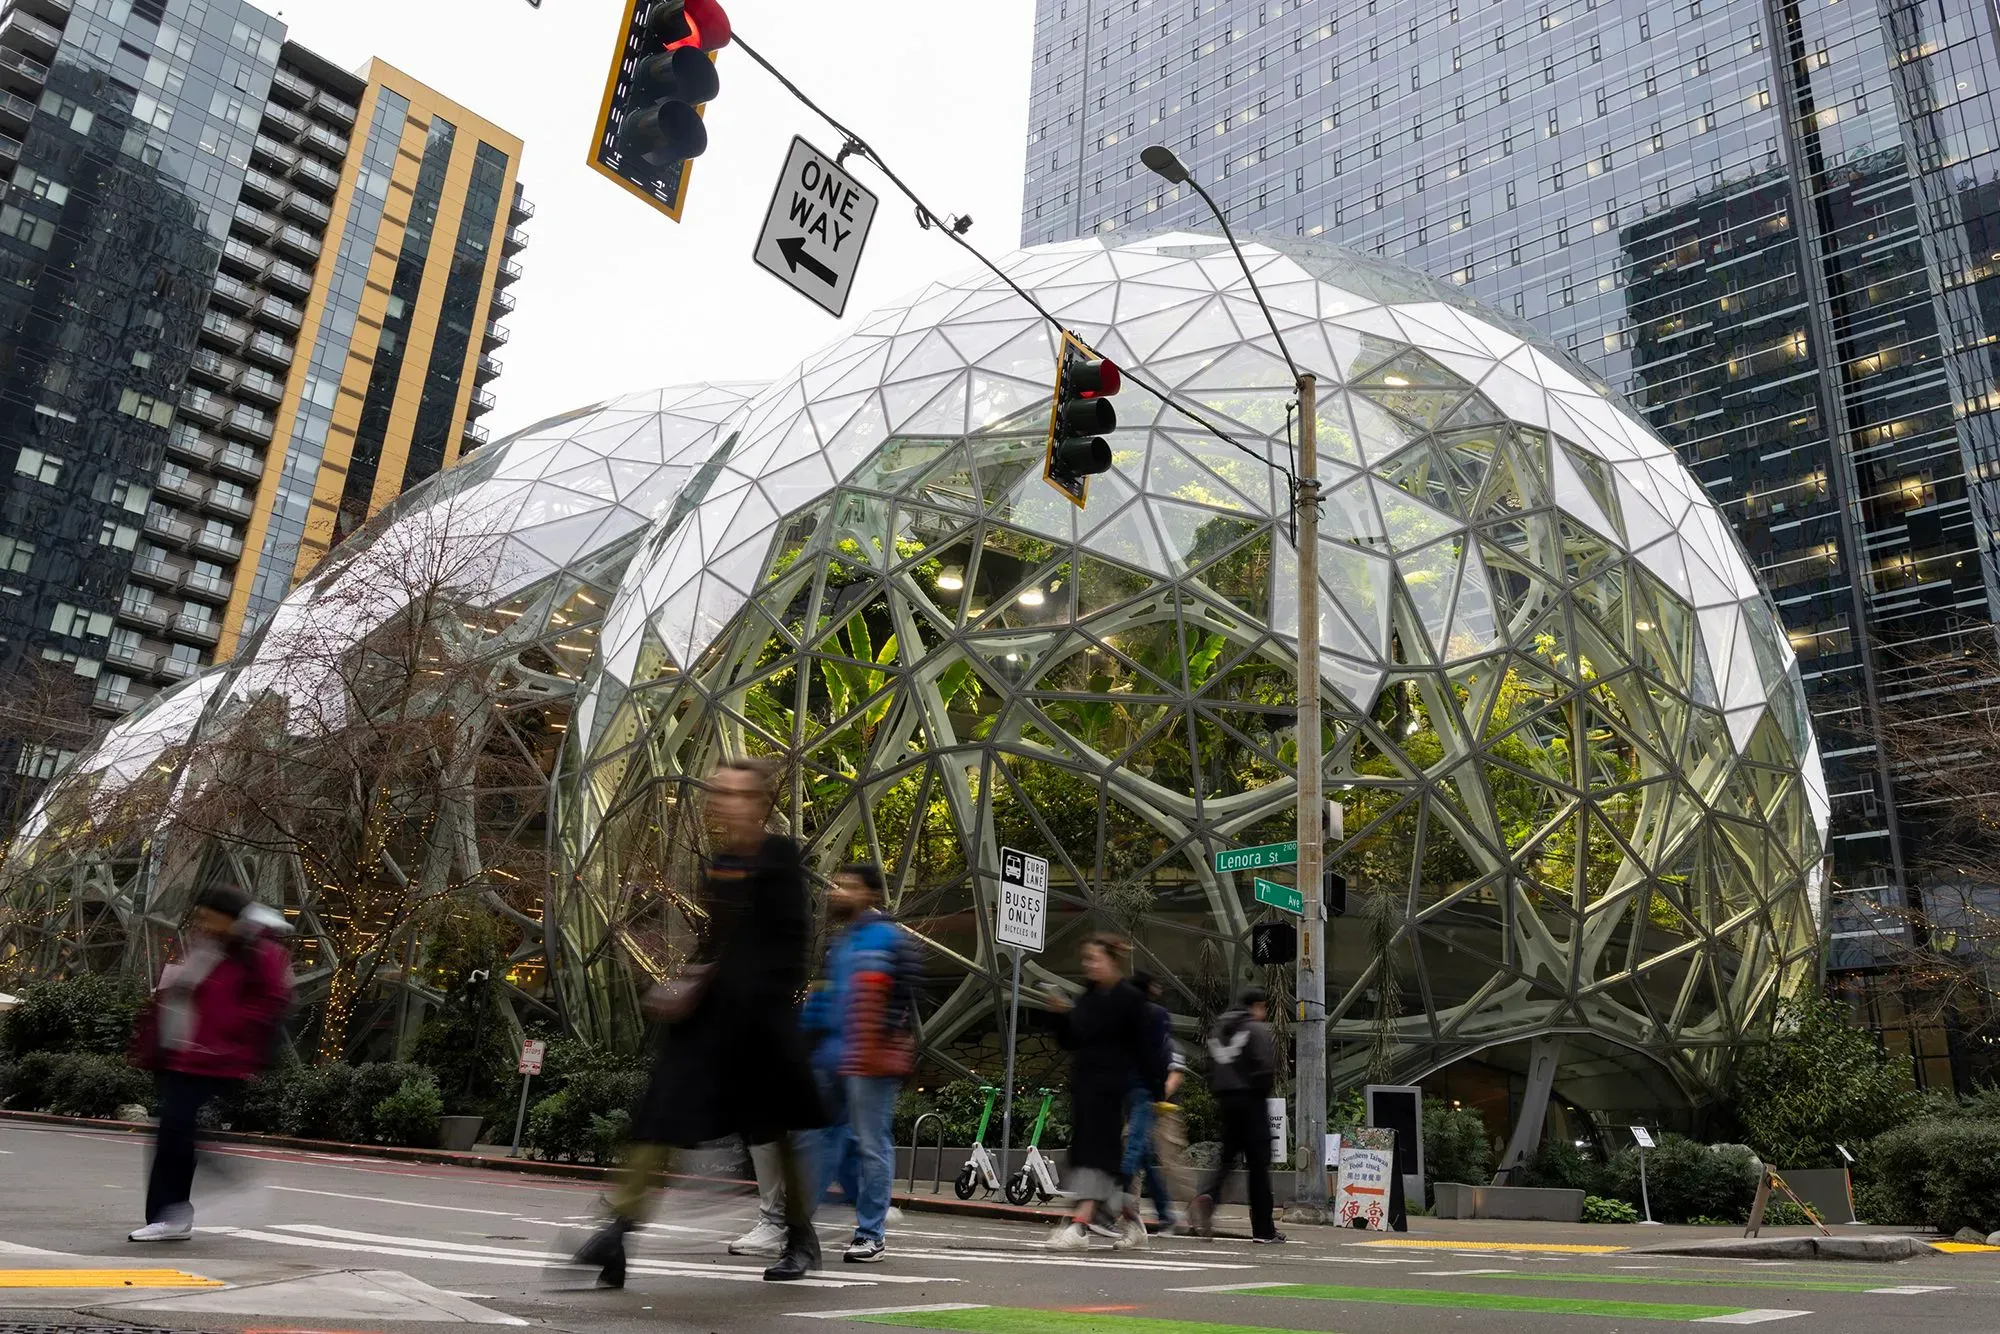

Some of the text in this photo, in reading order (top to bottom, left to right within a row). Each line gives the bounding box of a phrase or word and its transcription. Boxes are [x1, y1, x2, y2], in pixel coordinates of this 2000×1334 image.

[801, 160, 860, 223] ONE
[789, 190, 851, 252] WAY
[1026, 861, 1044, 875] CURB
[1221, 852, 1279, 869] Lenora St
[1026, 875, 1043, 887] LANE
[1005, 891, 1040, 912] BUSES
[1258, 882, 1300, 908] 7th Ave
[1008, 907, 1036, 926] ONLY
[1004, 923, 1037, 939] BICYCLES OK
[1370, 1153, 1389, 1168] Taiwan
